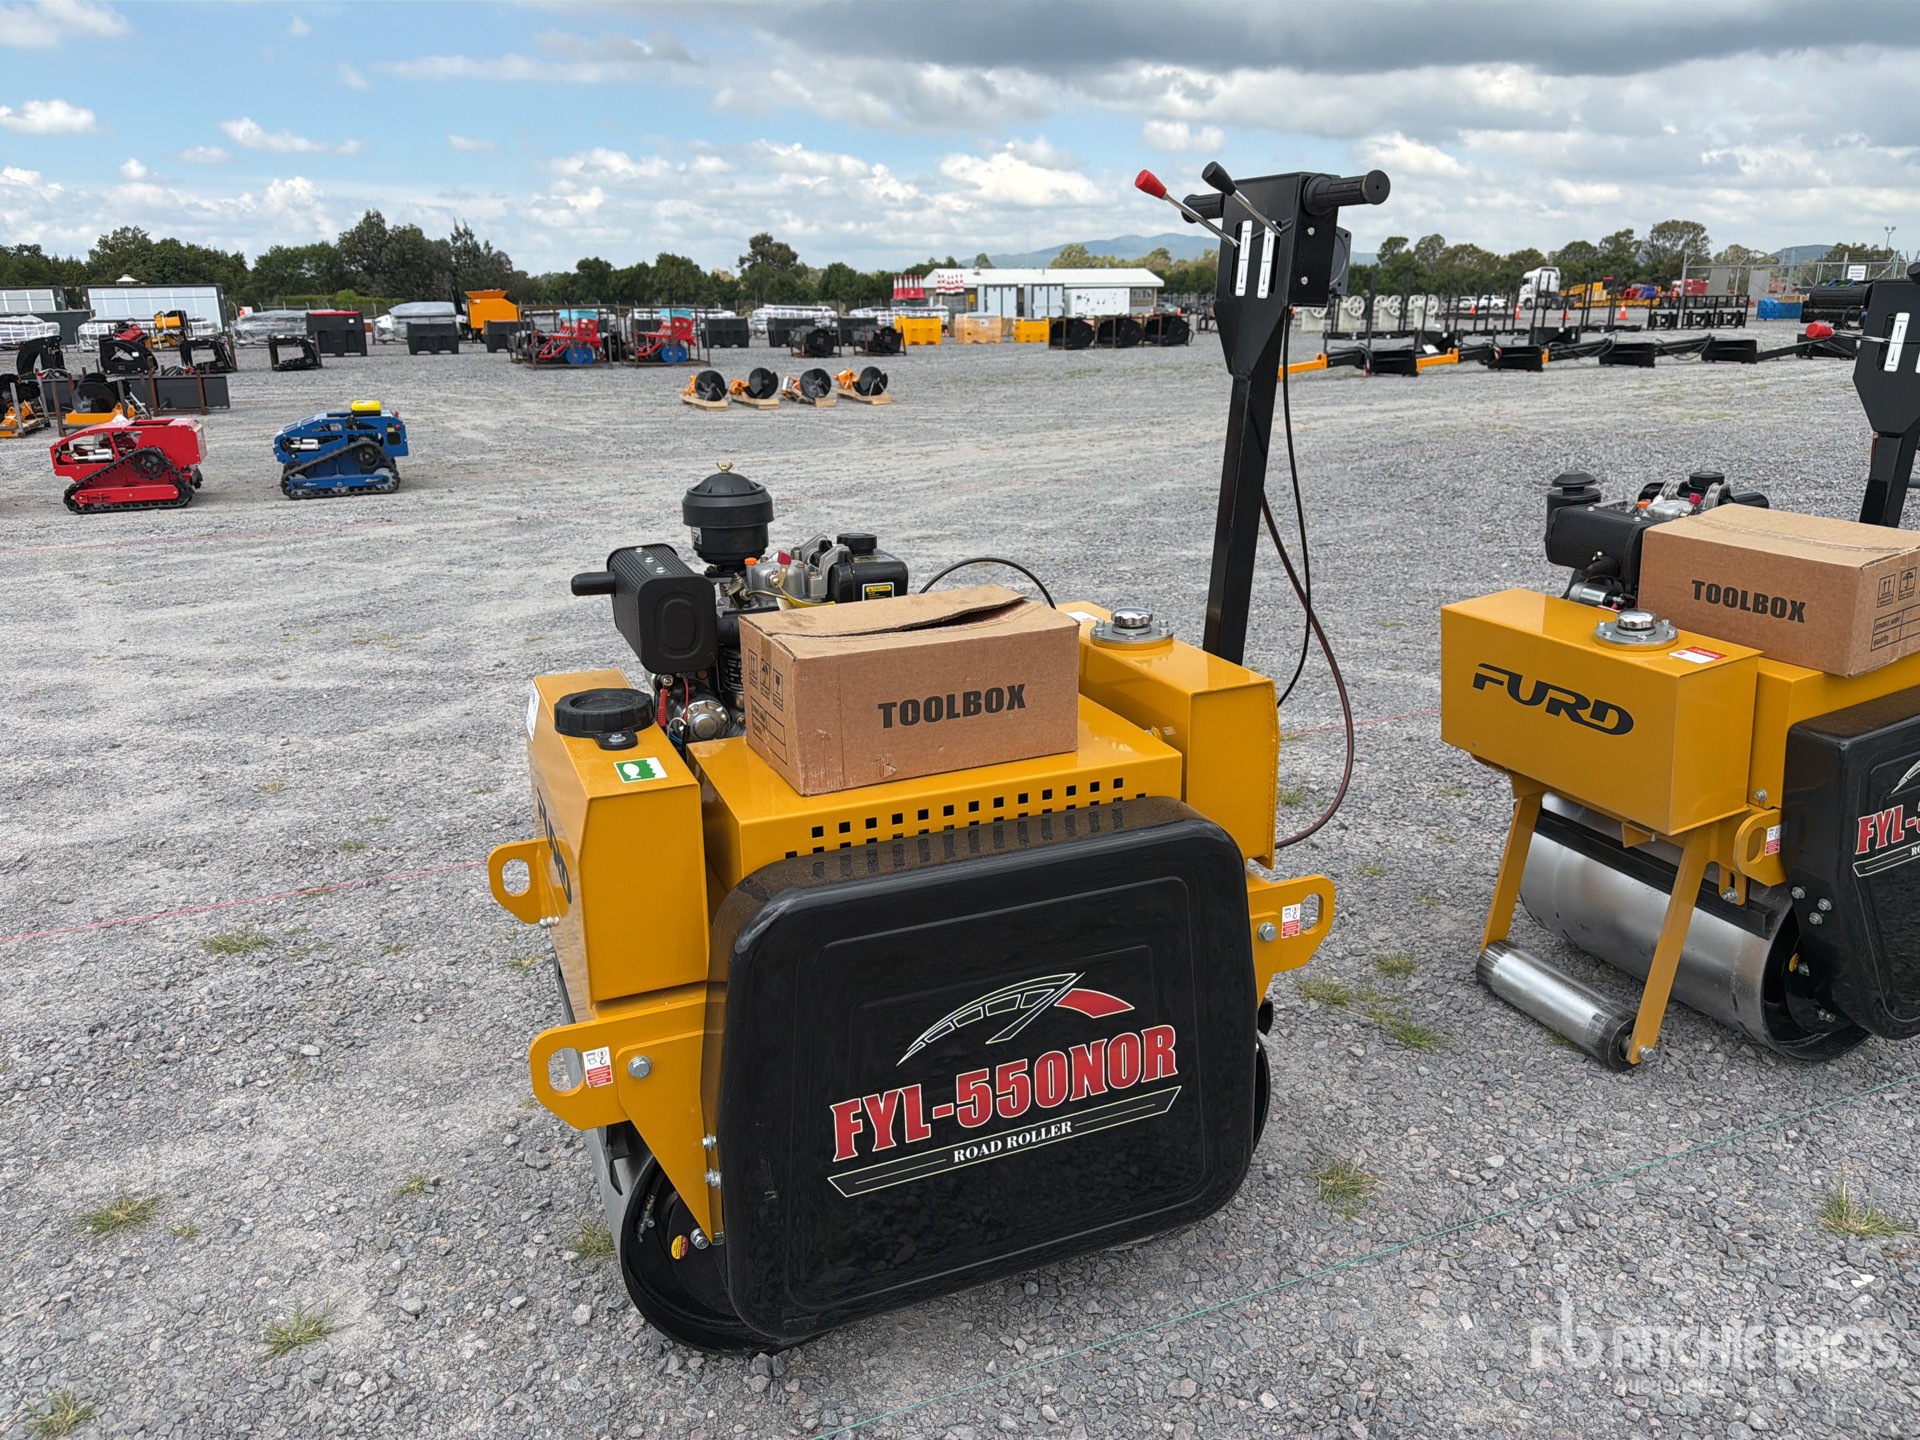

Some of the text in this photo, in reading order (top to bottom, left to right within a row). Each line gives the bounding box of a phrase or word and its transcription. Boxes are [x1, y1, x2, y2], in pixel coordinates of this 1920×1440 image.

[1691, 579, 1807, 624] TOOLBOX
[877, 684, 1026, 728] TOOLBOX
[1471, 662, 1635, 736] FURD
[1854, 802, 1920, 856] FYL-
[829, 1024, 1179, 1163] FYL-550NOR
[952, 1121, 1073, 1164] ROAD ROLLER
